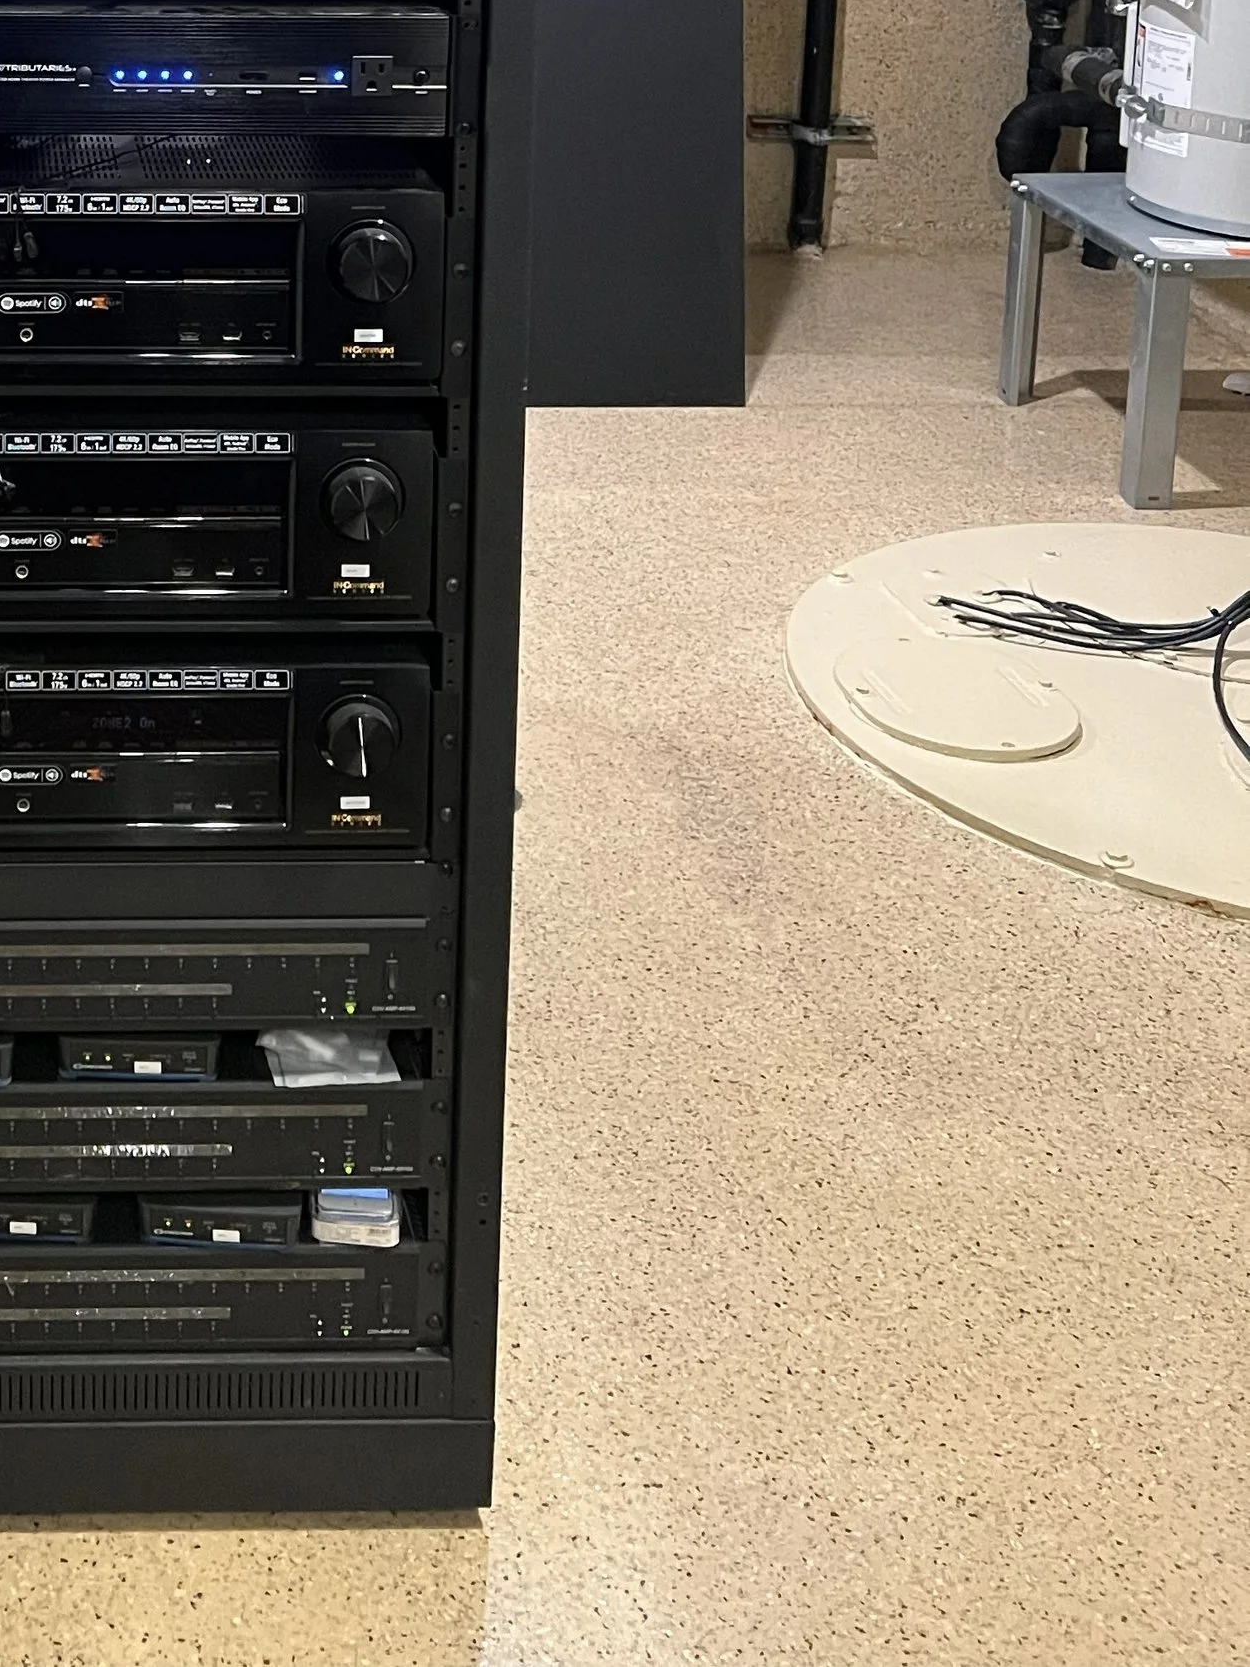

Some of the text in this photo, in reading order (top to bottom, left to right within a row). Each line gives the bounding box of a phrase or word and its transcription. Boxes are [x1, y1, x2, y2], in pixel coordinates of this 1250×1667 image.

[15, 299, 43, 309] Spotify
[10, 537, 38, 547] Spotify
[12, 770, 40, 780] Spotify
